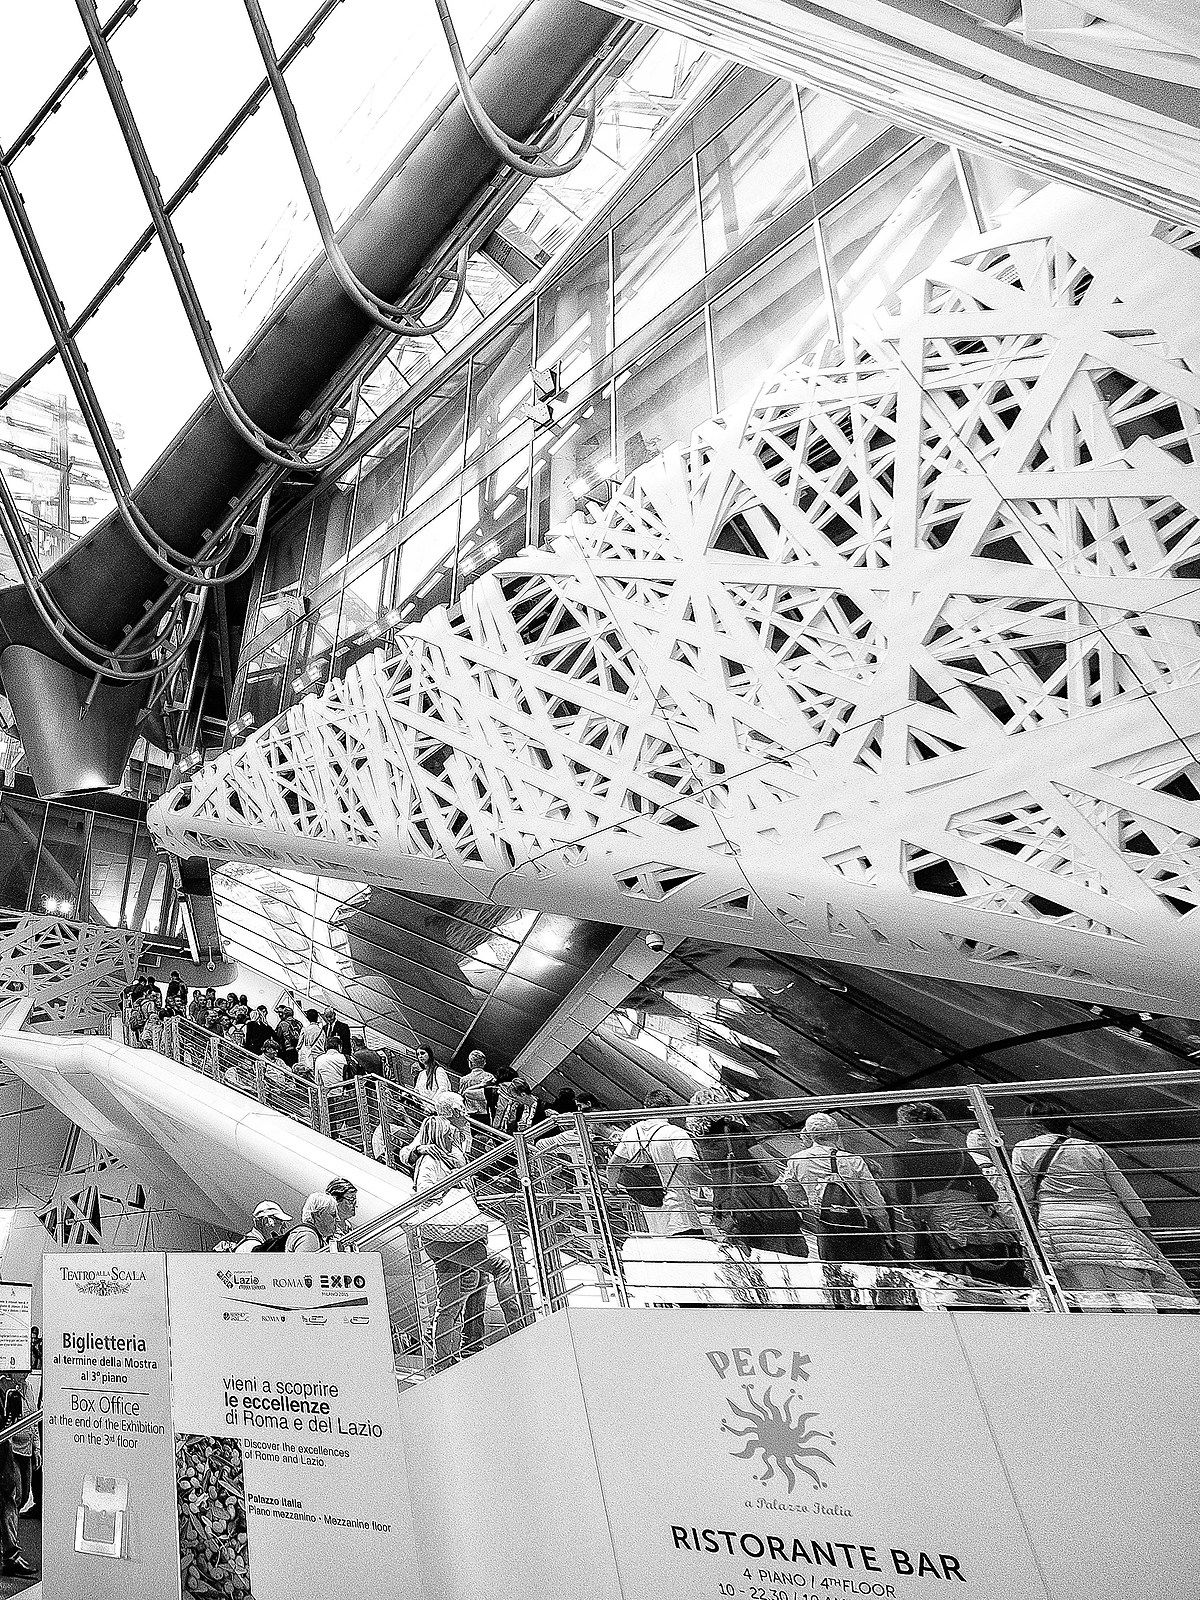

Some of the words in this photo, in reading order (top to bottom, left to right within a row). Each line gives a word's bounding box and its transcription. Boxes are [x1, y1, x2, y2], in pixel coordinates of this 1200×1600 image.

[60, 1266, 96, 1281] TEATRO
[111, 1266, 147, 1281] SCALA
[233, 1274, 260, 1285] Lazio
[272, 1278, 304, 1288] ROMA
[320, 1274, 366, 1289] EXPO
[62, 1332, 147, 1354] Biglietteria
[53, 1353, 61, 1365] al
[63, 1355, 97, 1367] termine
[99, 1356, 122, 1368] della
[124, 1357, 158, 1370] Mostra
[704, 1347, 812, 1383] PECK
[80, 1370, 89, 1381] al
[102, 1372, 128, 1385] piano
[222, 1374, 257, 1393] vieni
[262, 1380, 272, 1394] a
[276, 1380, 339, 1400] scoprire
[71, 1394, 96, 1413] Box
[99, 1395, 141, 1416] Office
[224, 1391, 239, 1408] le
[242, 1395, 331, 1415] eccellenze
[48, 1415, 58, 1425] at
[59, 1414, 73, 1427] the
[74, 1416, 91, 1428] end
[93, 1416, 103, 1429] of
[104, 1418, 120, 1431] the
[121, 1420, 165, 1435] Exhibition
[225, 1408, 238, 1426] di
[243, 1409, 290, 1431] Roma
[293, 1418, 303, 1431] e
[308, 1415, 333, 1434] del
[337, 1417, 384, 1438] Lazio
[73, 1434, 85, 1444] on
[87, 1432, 101, 1446] the
[103, 1433, 116, 1446] 3rd
[117, 1434, 139, 1449] floor
[244, 1438, 280, 1451] Discover
[282, 1441, 296, 1453] the
[298, 1444, 351, 1458] excellences
[244, 1450, 253, 1459] of
[255, 1450, 280, 1463] Rome
[282, 1454, 298, 1464] and
[300, 1455, 328, 1467] Lazio.
[247, 1493, 280, 1506] Palazzo
[281, 1496, 303, 1509] Italia
[744, 1500, 753, 1508] a
[813, 1501, 854, 1518] Italia
[248, 1504, 271, 1517] Piano
[272, 1509, 317, 1523] mezzanino
[323, 1514, 370, 1530] Mezzanine
[372, 1520, 392, 1533] floor
[670, 1524, 883, 1573] RISTORANTE
[889, 1547, 968, 1583] BAR
[718, 1582, 735, 1597] 10
[742, 1567, 752, 1580] 4
[758, 1569, 806, 1587] PIANO
[843, 1579, 897, 1599] FLOOR
